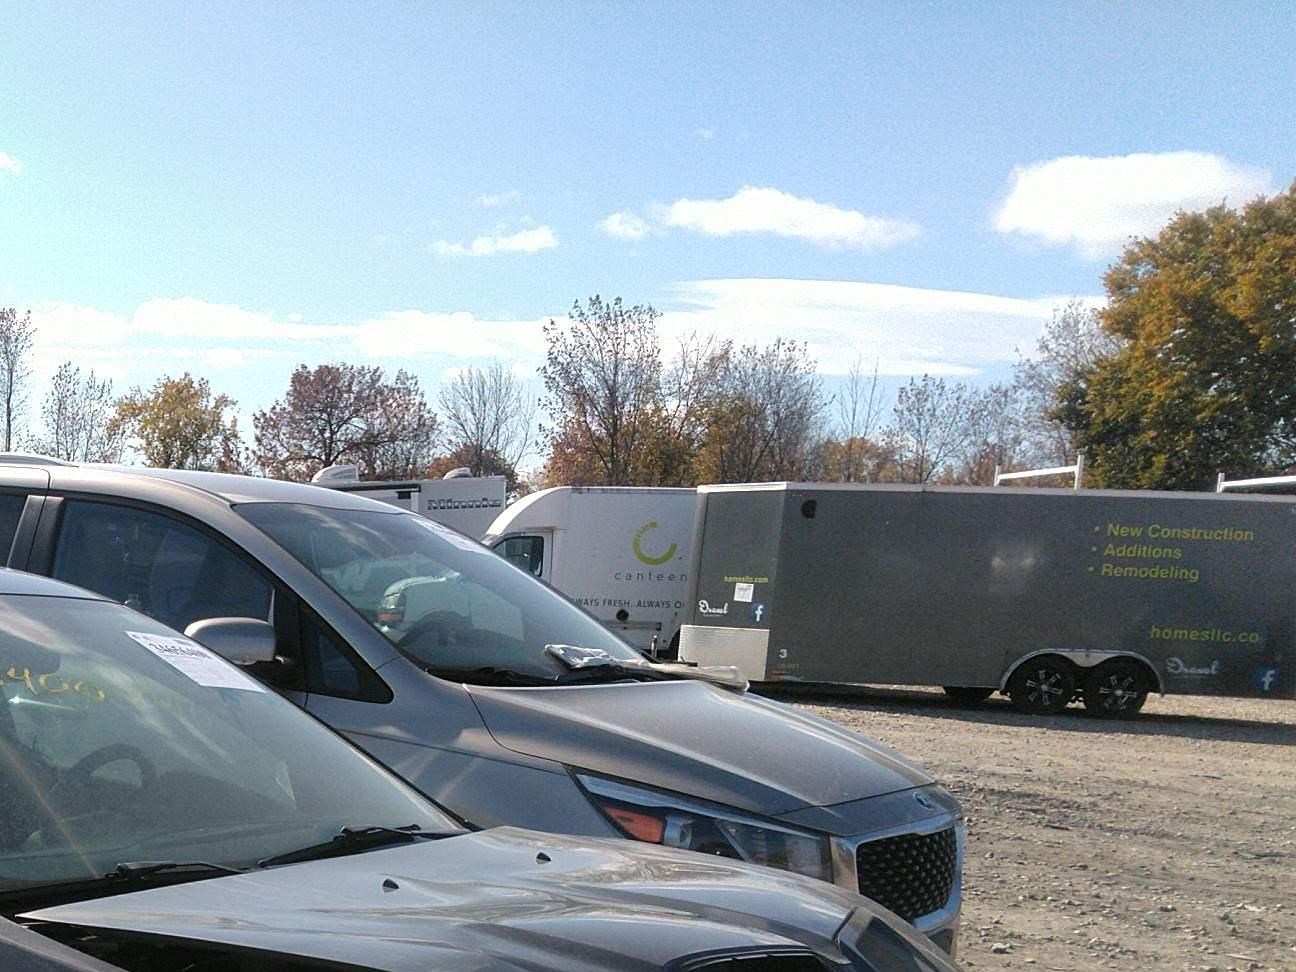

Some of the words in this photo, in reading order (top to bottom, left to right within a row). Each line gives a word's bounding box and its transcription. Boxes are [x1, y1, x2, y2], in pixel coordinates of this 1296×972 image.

[1107, 523, 1143, 537] New
[1148, 524, 1254, 541] Construction
[1104, 543, 1183, 559] Additions
[614, 571, 688, 582] canteen
[1101, 563, 1200, 583] Remodeling
[603, 599, 633, 608] FRESH.
[636, 599, 671, 609] ALWAYS
[778, 648, 788, 659] 3
